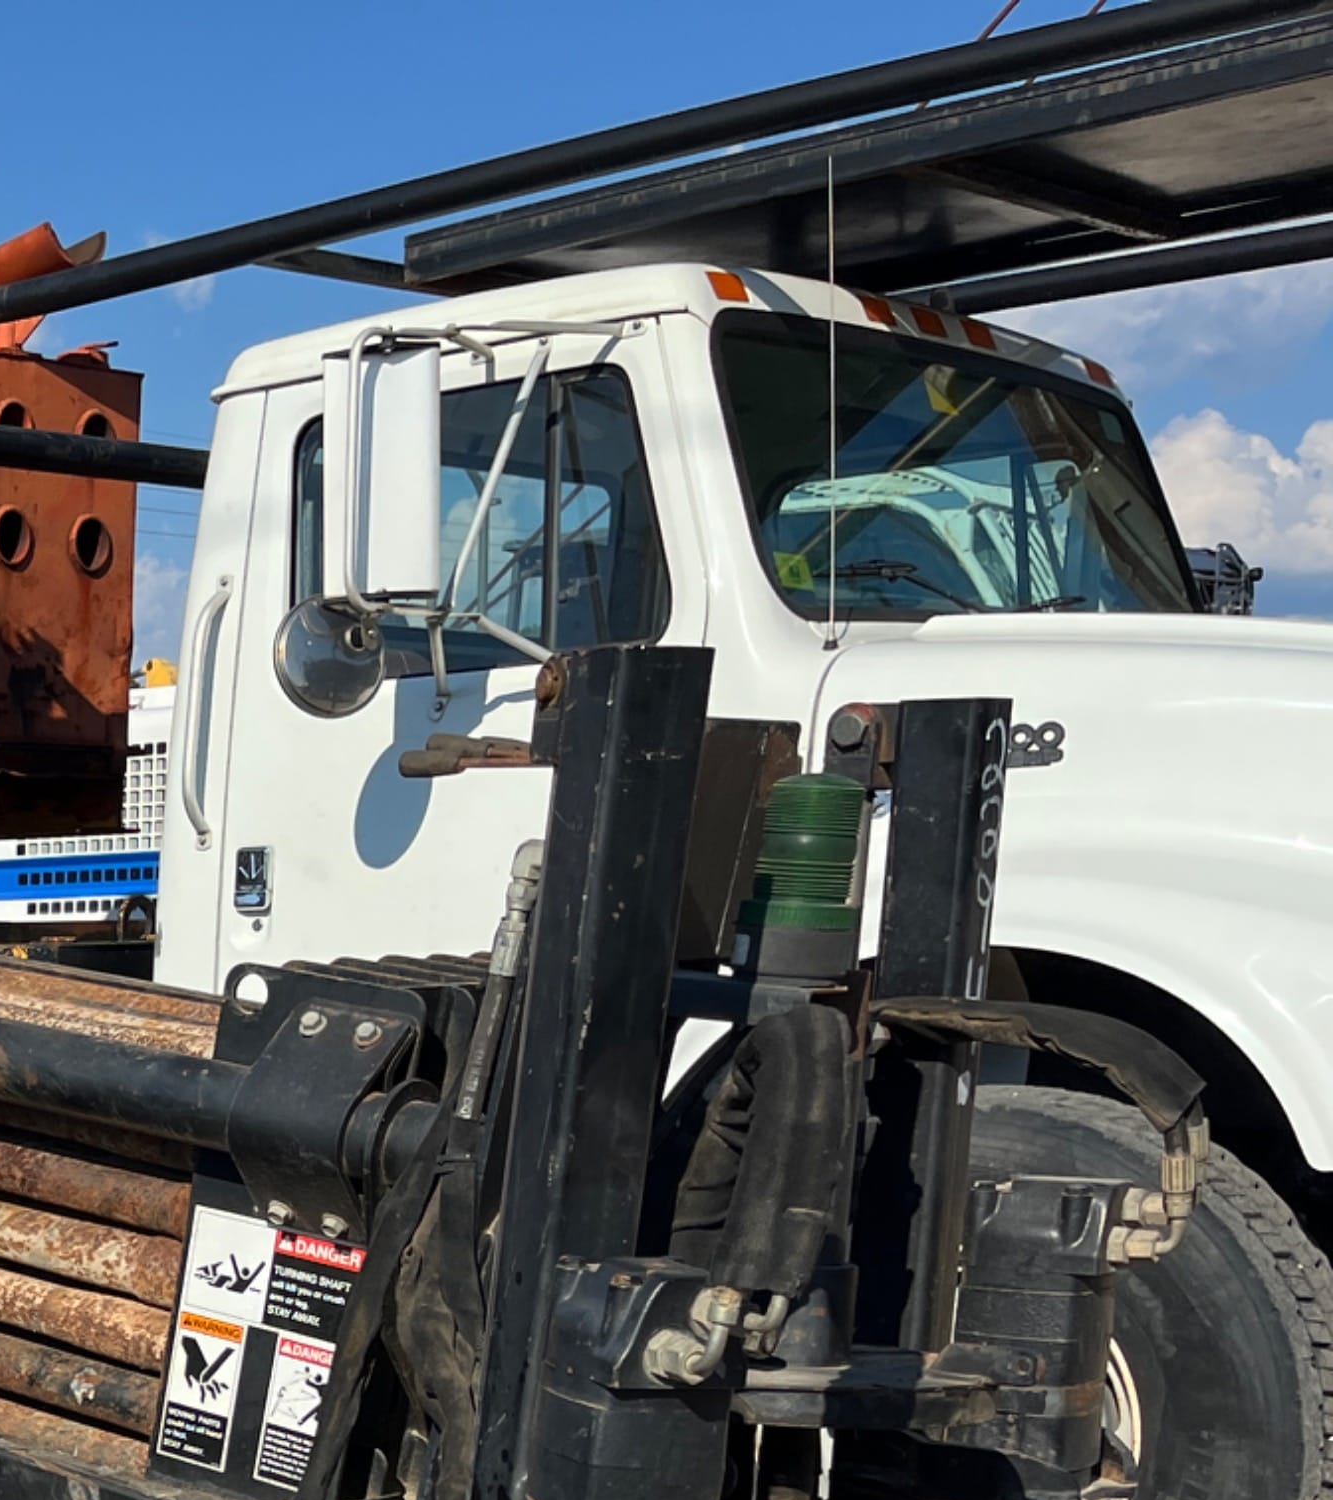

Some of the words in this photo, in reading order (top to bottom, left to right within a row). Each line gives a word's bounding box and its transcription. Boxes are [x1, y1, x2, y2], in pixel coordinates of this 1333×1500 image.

[294, 1238, 362, 1269] DANGER
[274, 1264, 318, 1285] TURNING
[318, 1275, 352, 1293] SHAFT
[267, 1304, 292, 1319] STAY
[193, 1318, 241, 1340] WARNING
